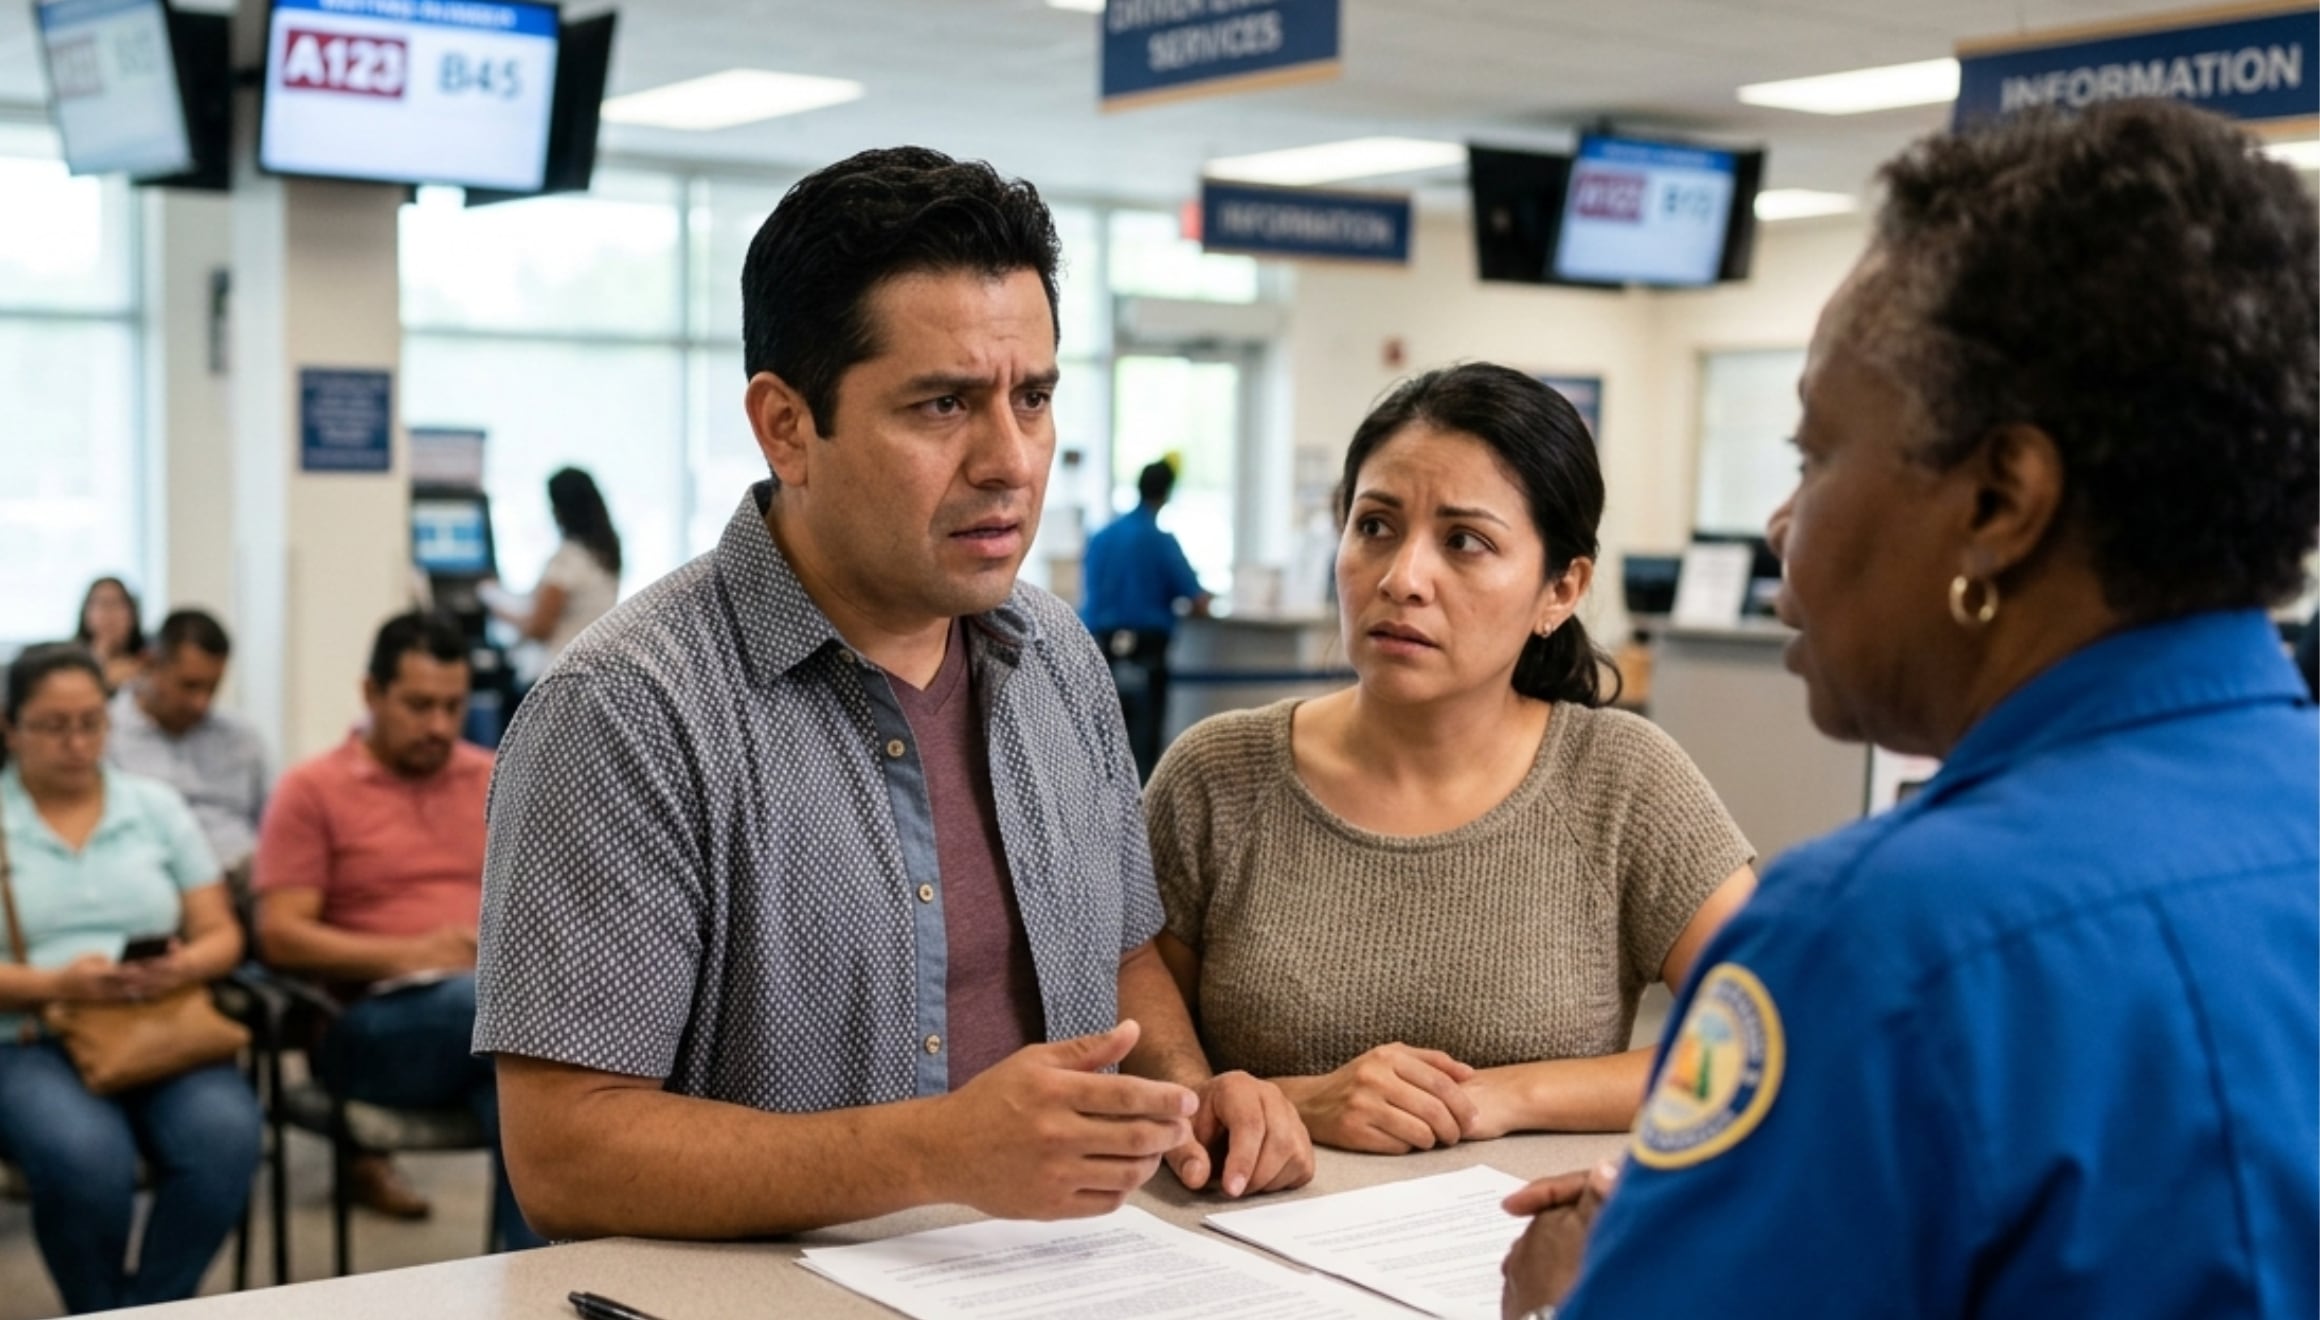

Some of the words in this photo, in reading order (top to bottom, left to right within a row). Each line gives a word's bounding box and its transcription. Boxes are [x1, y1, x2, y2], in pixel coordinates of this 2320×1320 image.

[283, 29, 404, 95] A123
[437, 49, 525, 98] B45
[1148, 10, 1284, 72] SERVICES
[2001, 42, 2304, 115] INFORMATION
